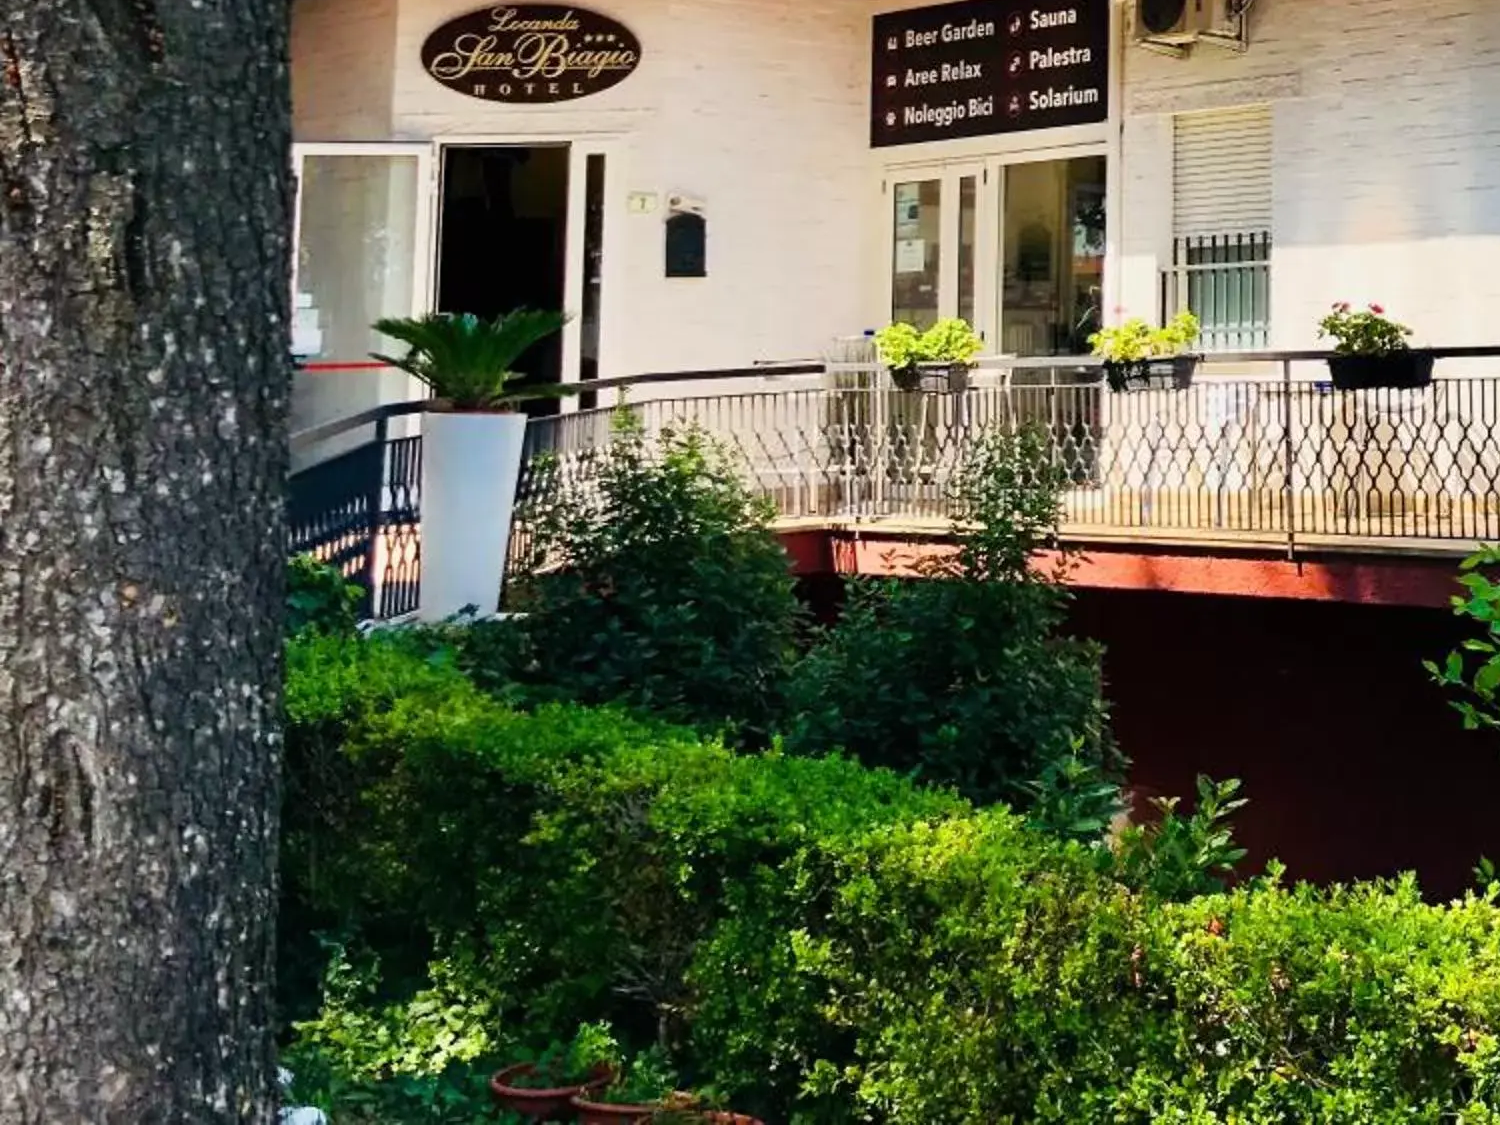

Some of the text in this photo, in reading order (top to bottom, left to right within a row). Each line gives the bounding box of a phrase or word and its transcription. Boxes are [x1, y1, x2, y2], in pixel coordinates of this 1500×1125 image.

[488, 7, 579, 31] Locanda
[1029, 7, 1077, 29] Sauna
[905, 19, 995, 48] Beer Garden
[432, 32, 636, 80] San Biagio
[1029, 47, 1091, 70] Palestra
[904, 60, 982, 87] Aree Relax
[474, 82, 584, 96] HOTEL
[1029, 85, 1098, 111] Solarium
[904, 94, 994, 126] Noleggio Bici
